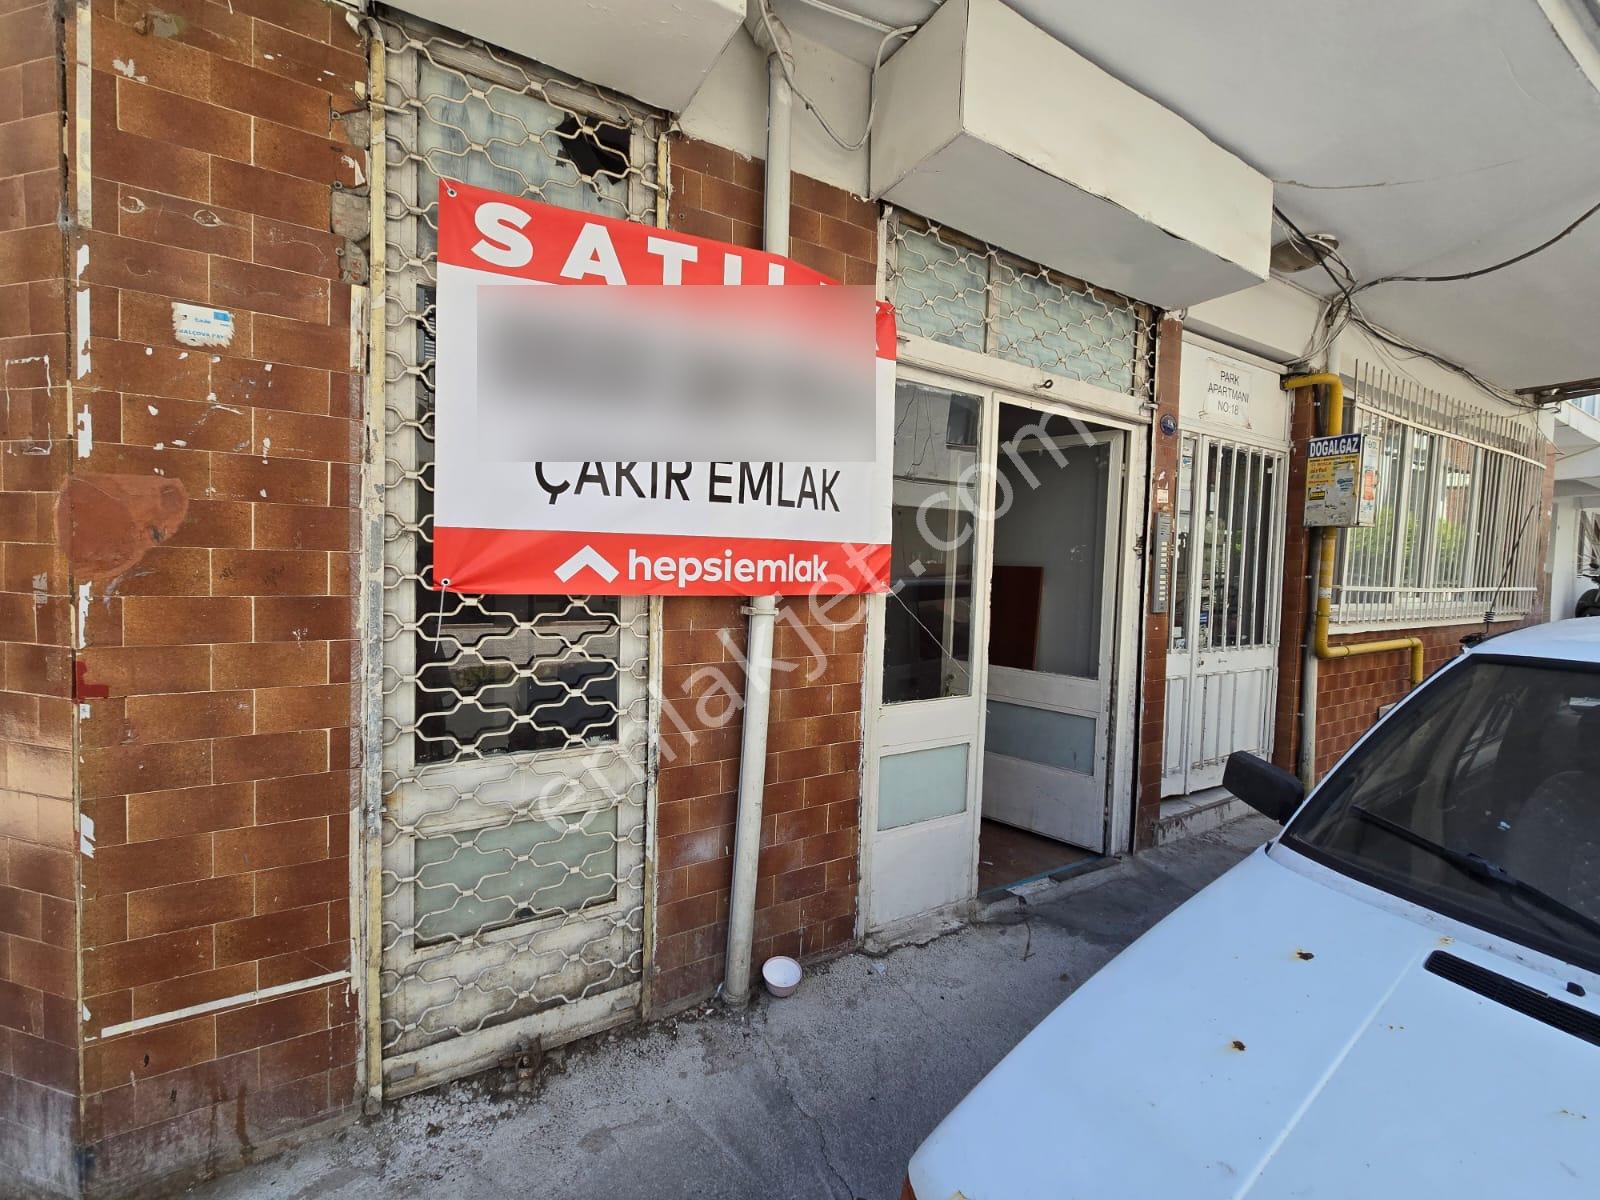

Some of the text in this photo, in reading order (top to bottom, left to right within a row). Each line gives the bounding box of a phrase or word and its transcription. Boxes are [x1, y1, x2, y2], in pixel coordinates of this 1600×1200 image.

[1220, 370, 1240, 386] PARK
[534, 461, 841, 513] ÇAKIR EMLAK
[628, 547, 829, 589] hepsiemlak
